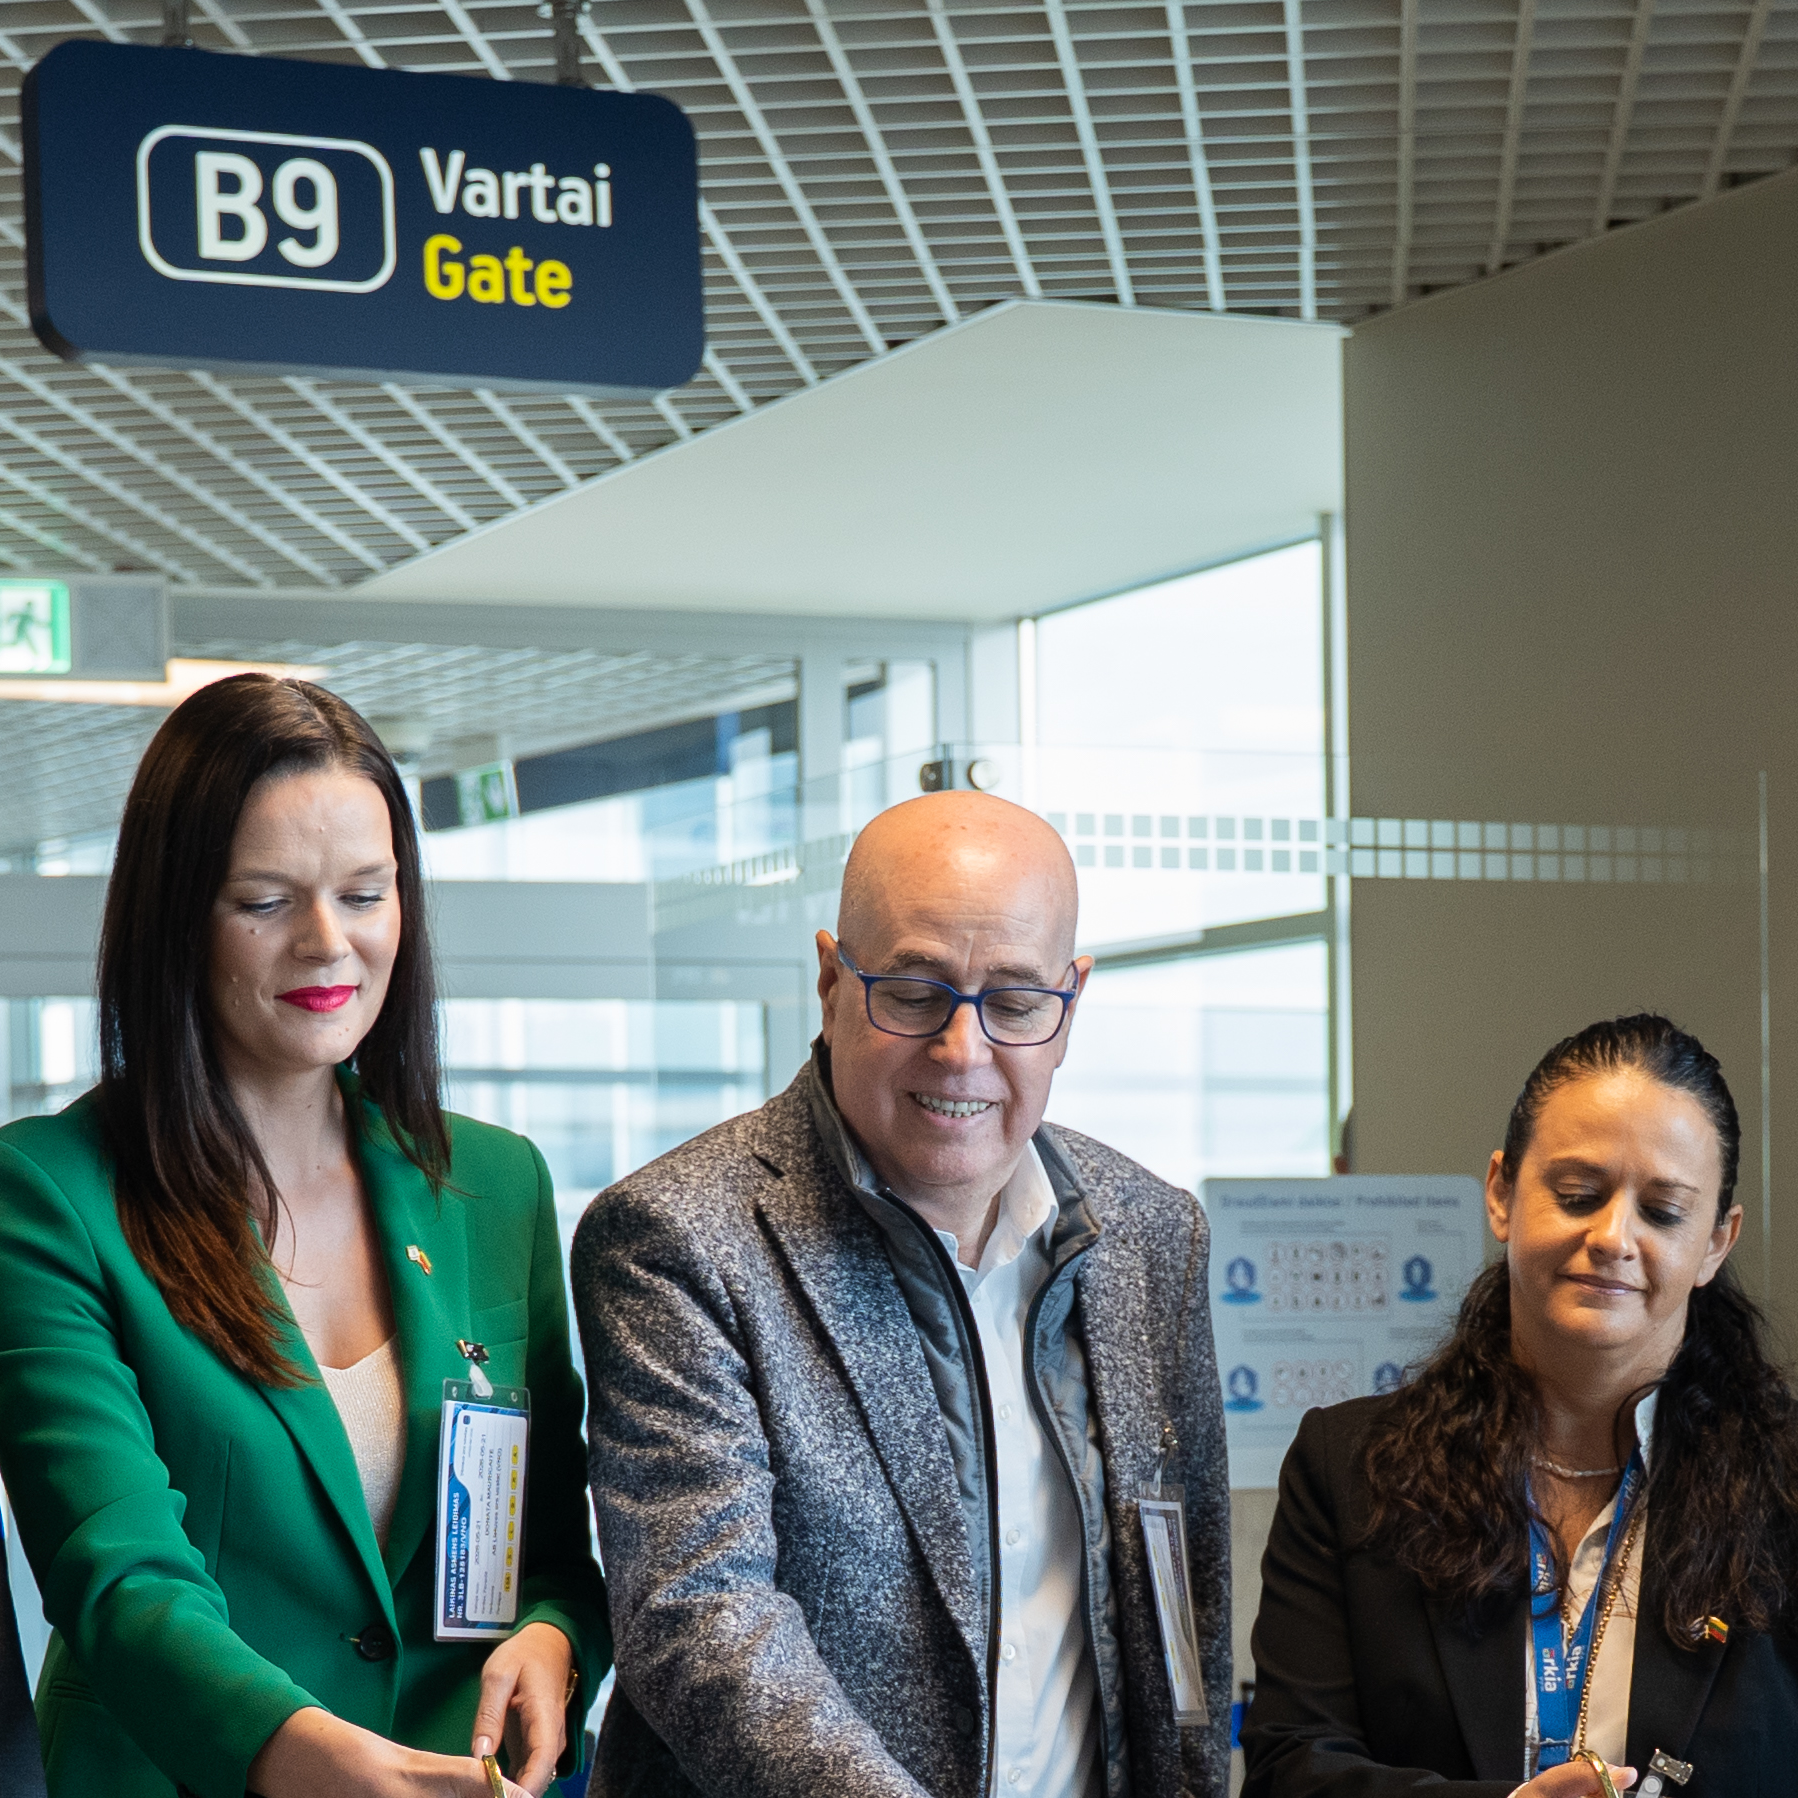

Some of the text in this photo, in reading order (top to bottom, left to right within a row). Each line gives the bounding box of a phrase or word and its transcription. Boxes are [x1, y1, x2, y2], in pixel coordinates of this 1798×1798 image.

[195, 151, 340, 268] B9
[419, 147, 612, 228] Vartai
[423, 234, 573, 309] Gate
